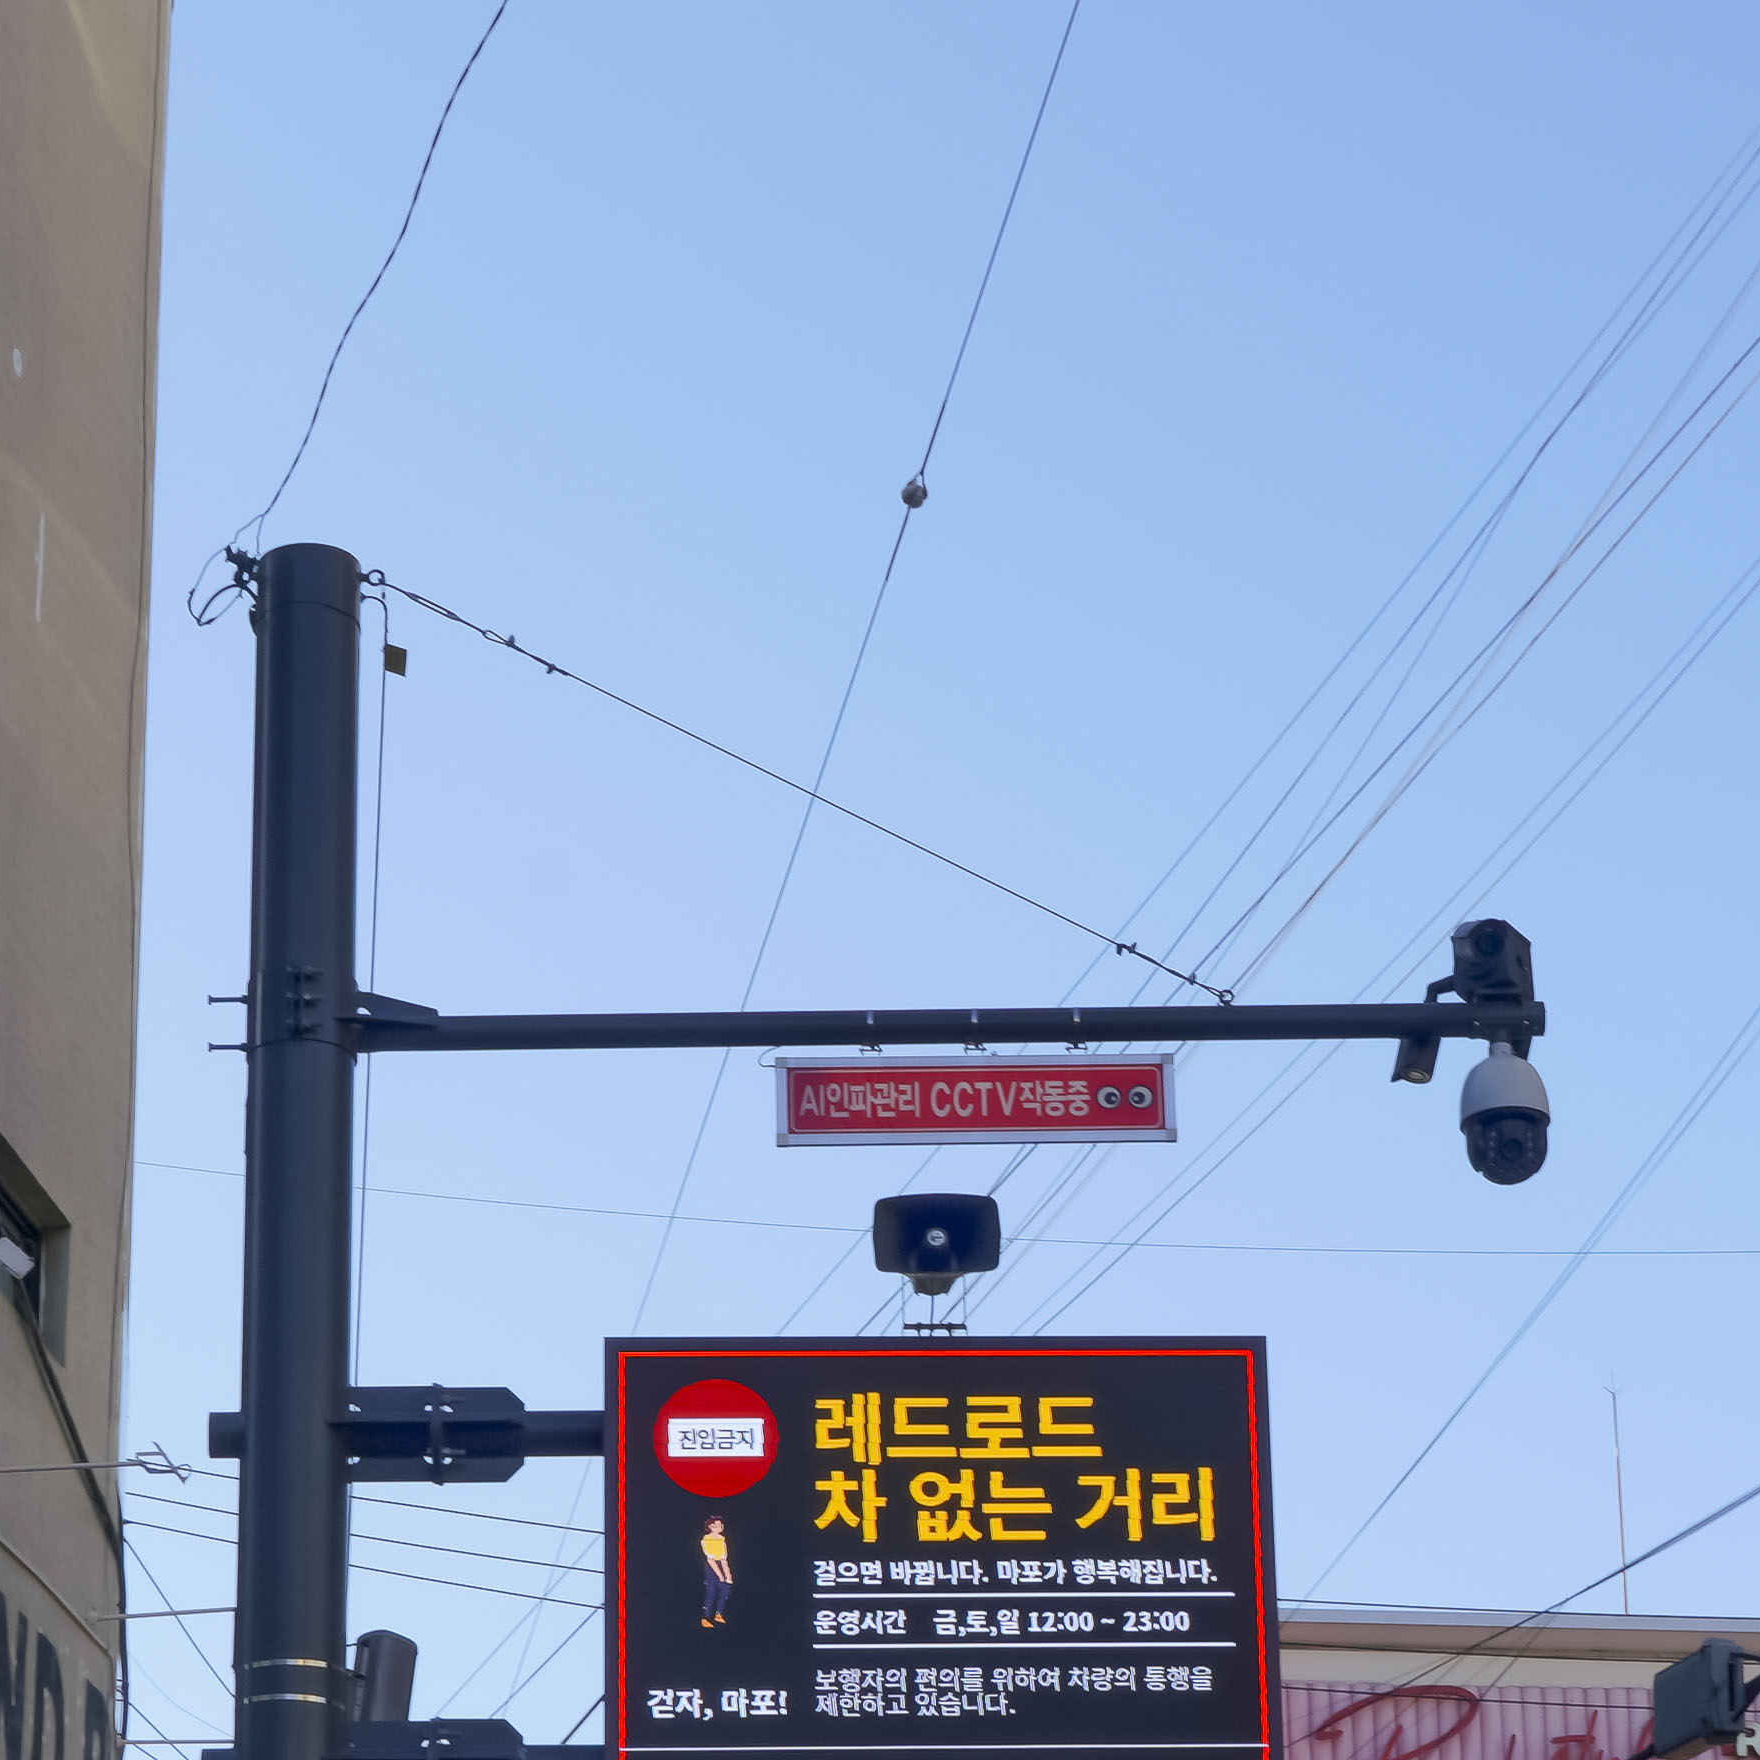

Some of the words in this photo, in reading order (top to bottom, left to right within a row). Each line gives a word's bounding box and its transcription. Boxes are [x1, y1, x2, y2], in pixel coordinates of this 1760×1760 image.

[798, 1081, 921, 1120] AI인파관리
[929, 1079, 1091, 1118] CCTV작동중
[677, 1427, 755, 1450] 진입금지
[814, 1391, 1103, 1466] 레드로드
[813, 1468, 887, 1543] 차
[906, 1469, 1053, 1542] 없는
[1074, 1466, 1217, 1542] 거리
[813, 1559, 883, 1586] 걸으면
[995, 1558, 1067, 1585] 마포가
[1070, 1557, 1219, 1586] 행복해집니다.
[813, 1610, 907, 1636] 운영시간
[932, 1609, 1021, 1637] 금,토,일
[1027, 1610, 1095, 1633] 12:00
[1122, 1610, 1191, 1633] 23:00
[814, 1667, 908, 1693] 보행자의
[914, 1667, 984, 1692] 편의를
[990, 1666, 1061, 1692] 위하여
[1067, 1666, 1137, 1692] 차량의
[1142, 1665, 1214, 1692] 통행을
[646, 1687, 714, 1722] 걷자,
[720, 1686, 789, 1719] 마포!
[814, 1692, 910, 1718] 제한하고
[914, 1692, 1017, 1717] 있습니다.
